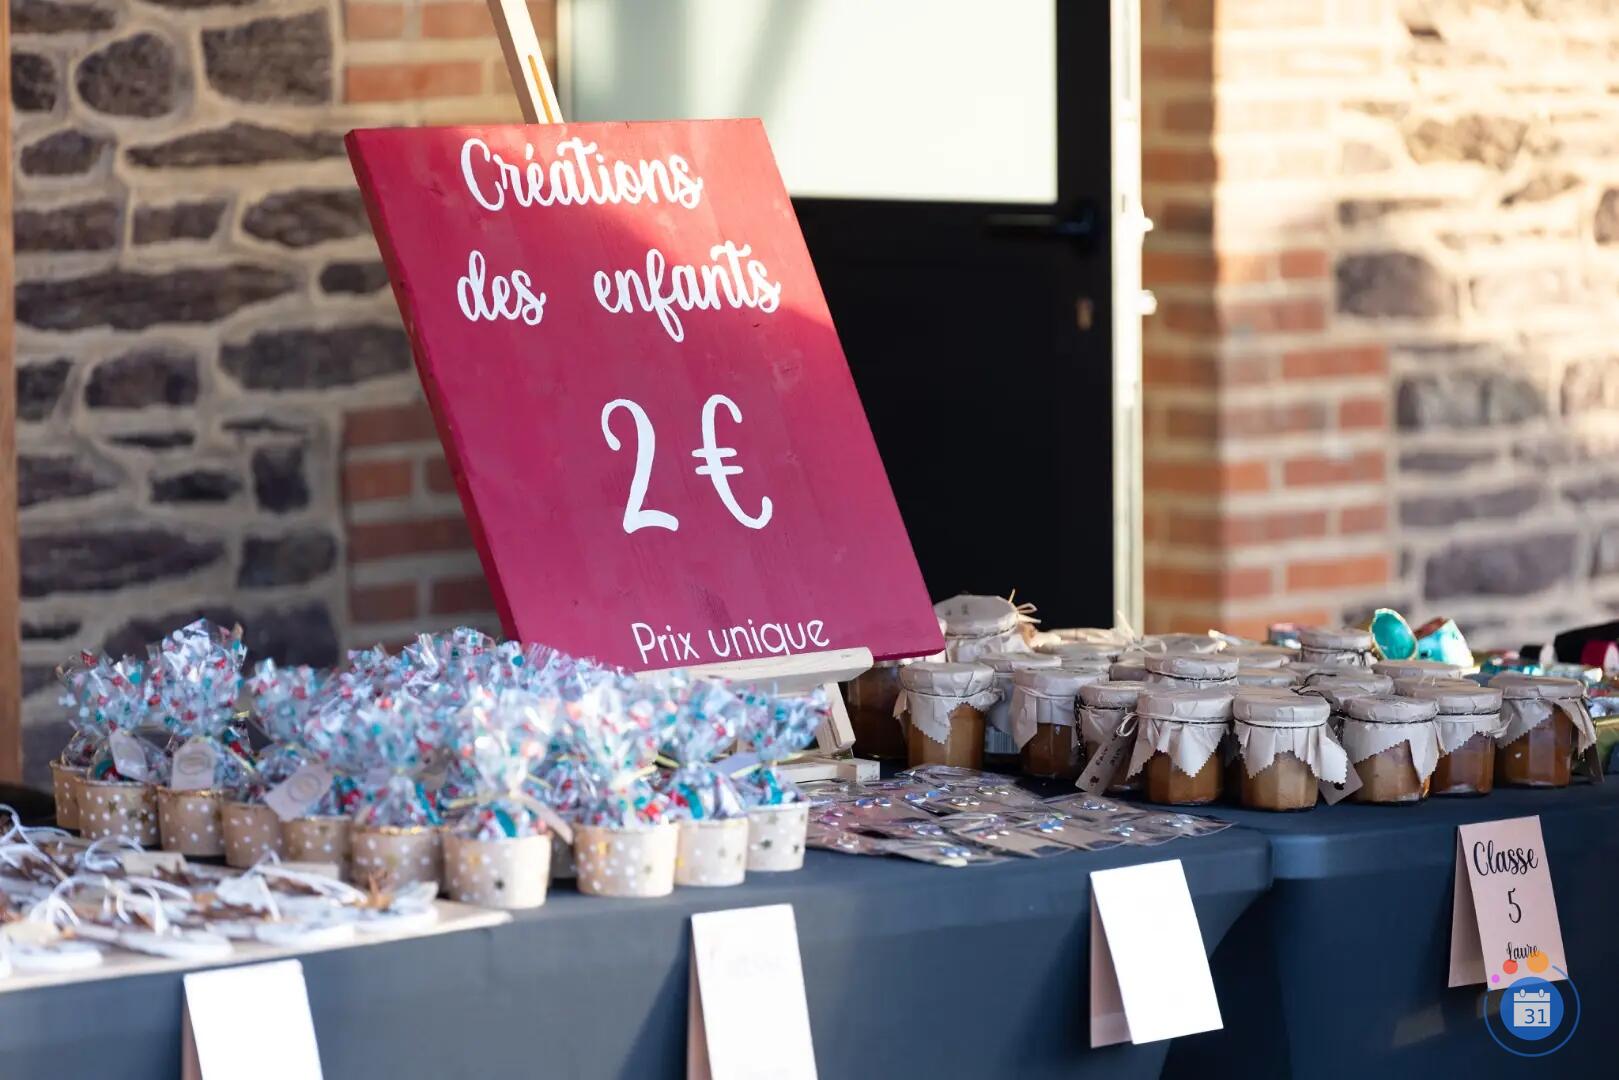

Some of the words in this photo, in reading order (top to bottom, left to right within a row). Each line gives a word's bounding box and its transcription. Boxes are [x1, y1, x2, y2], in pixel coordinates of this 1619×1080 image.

[461, 137, 703, 211] Créations
[457, 251, 546, 325] des
[594, 240, 781, 342] enfants
[602, 399, 678, 533] 2
[692, 395, 772, 529] €
[632, 622, 700, 665] Prix
[707, 619, 831, 658] unique
[1473, 840, 1539, 876] Classe
[1507, 888, 1522, 924] 5
